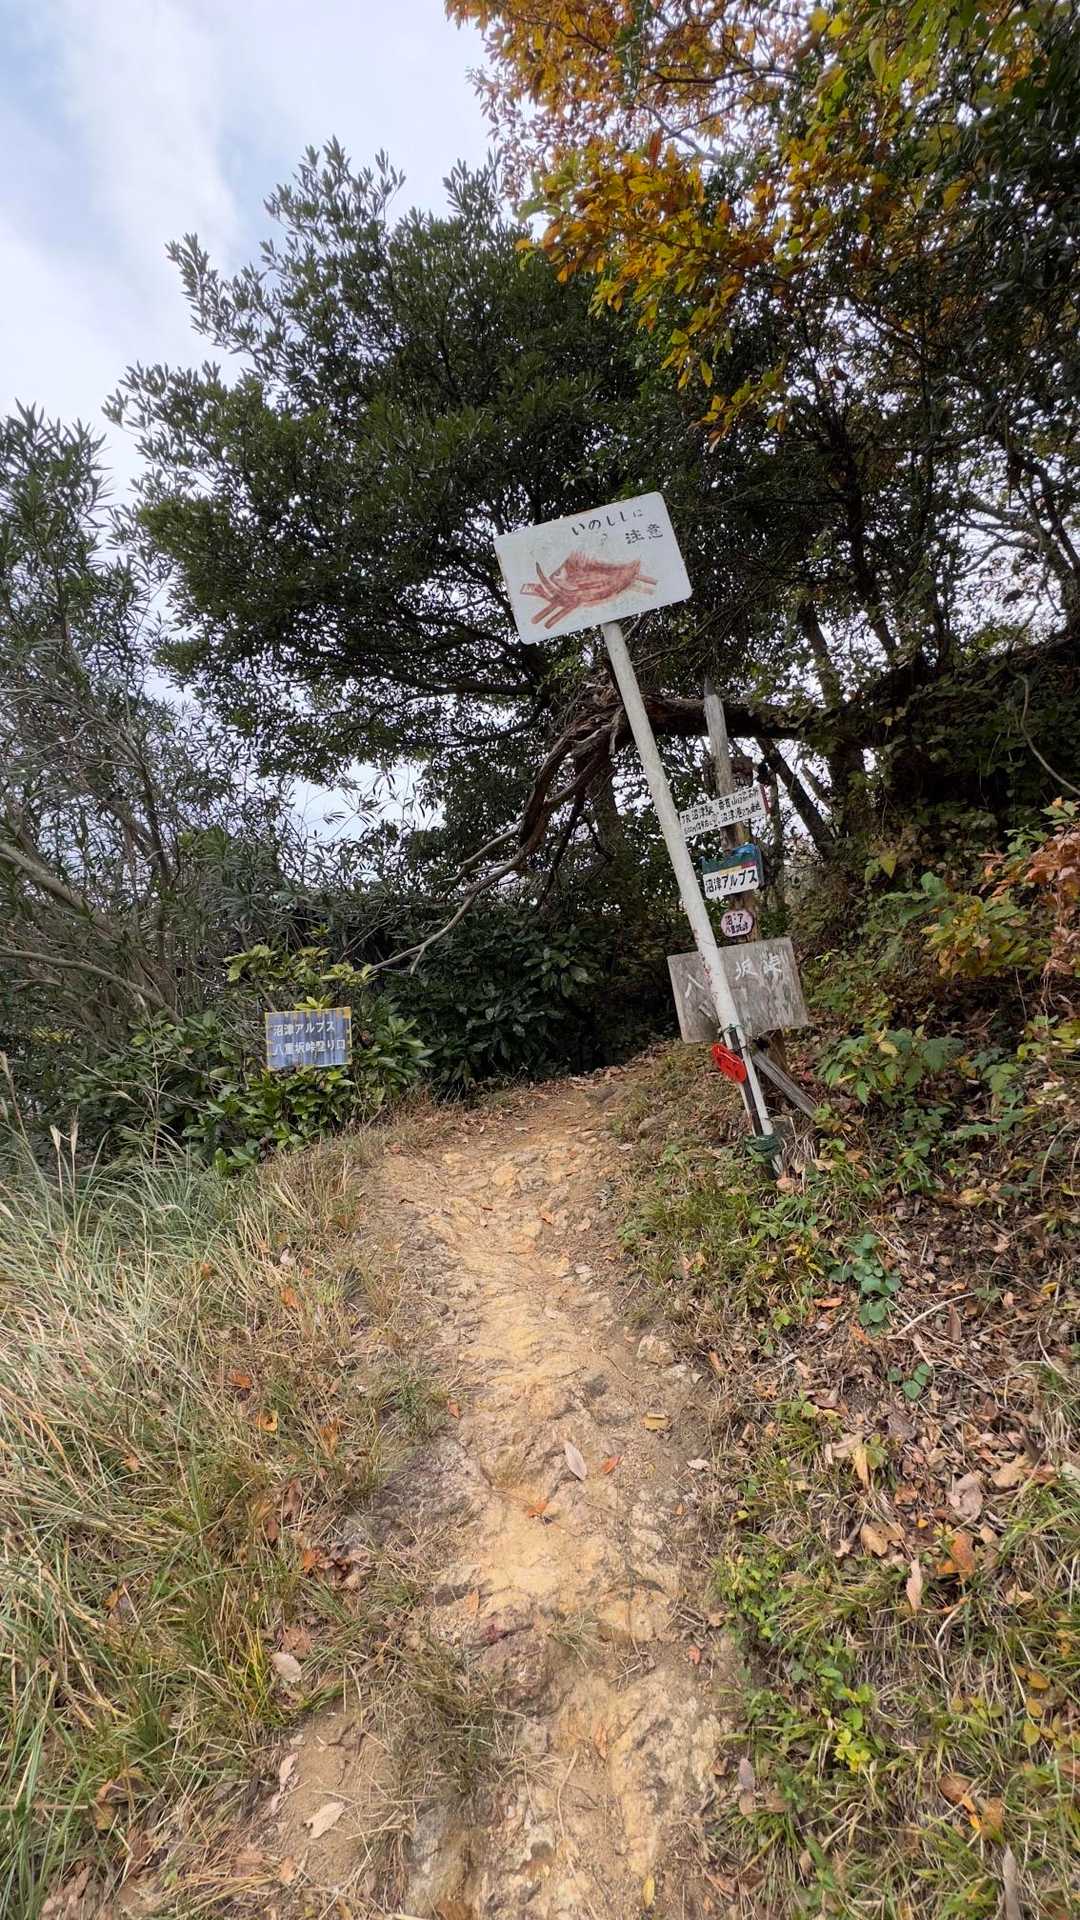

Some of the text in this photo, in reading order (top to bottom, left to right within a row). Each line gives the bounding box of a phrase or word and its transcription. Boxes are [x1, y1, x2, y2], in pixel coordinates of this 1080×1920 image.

[572, 509, 643, 536] いのししに
[625, 523, 664, 544] 注意
[705, 870, 758, 893] 沼津アルプス
[684, 952, 783, 998] 八坂峠
[273, 1020, 336, 1036] 沼津アルプス
